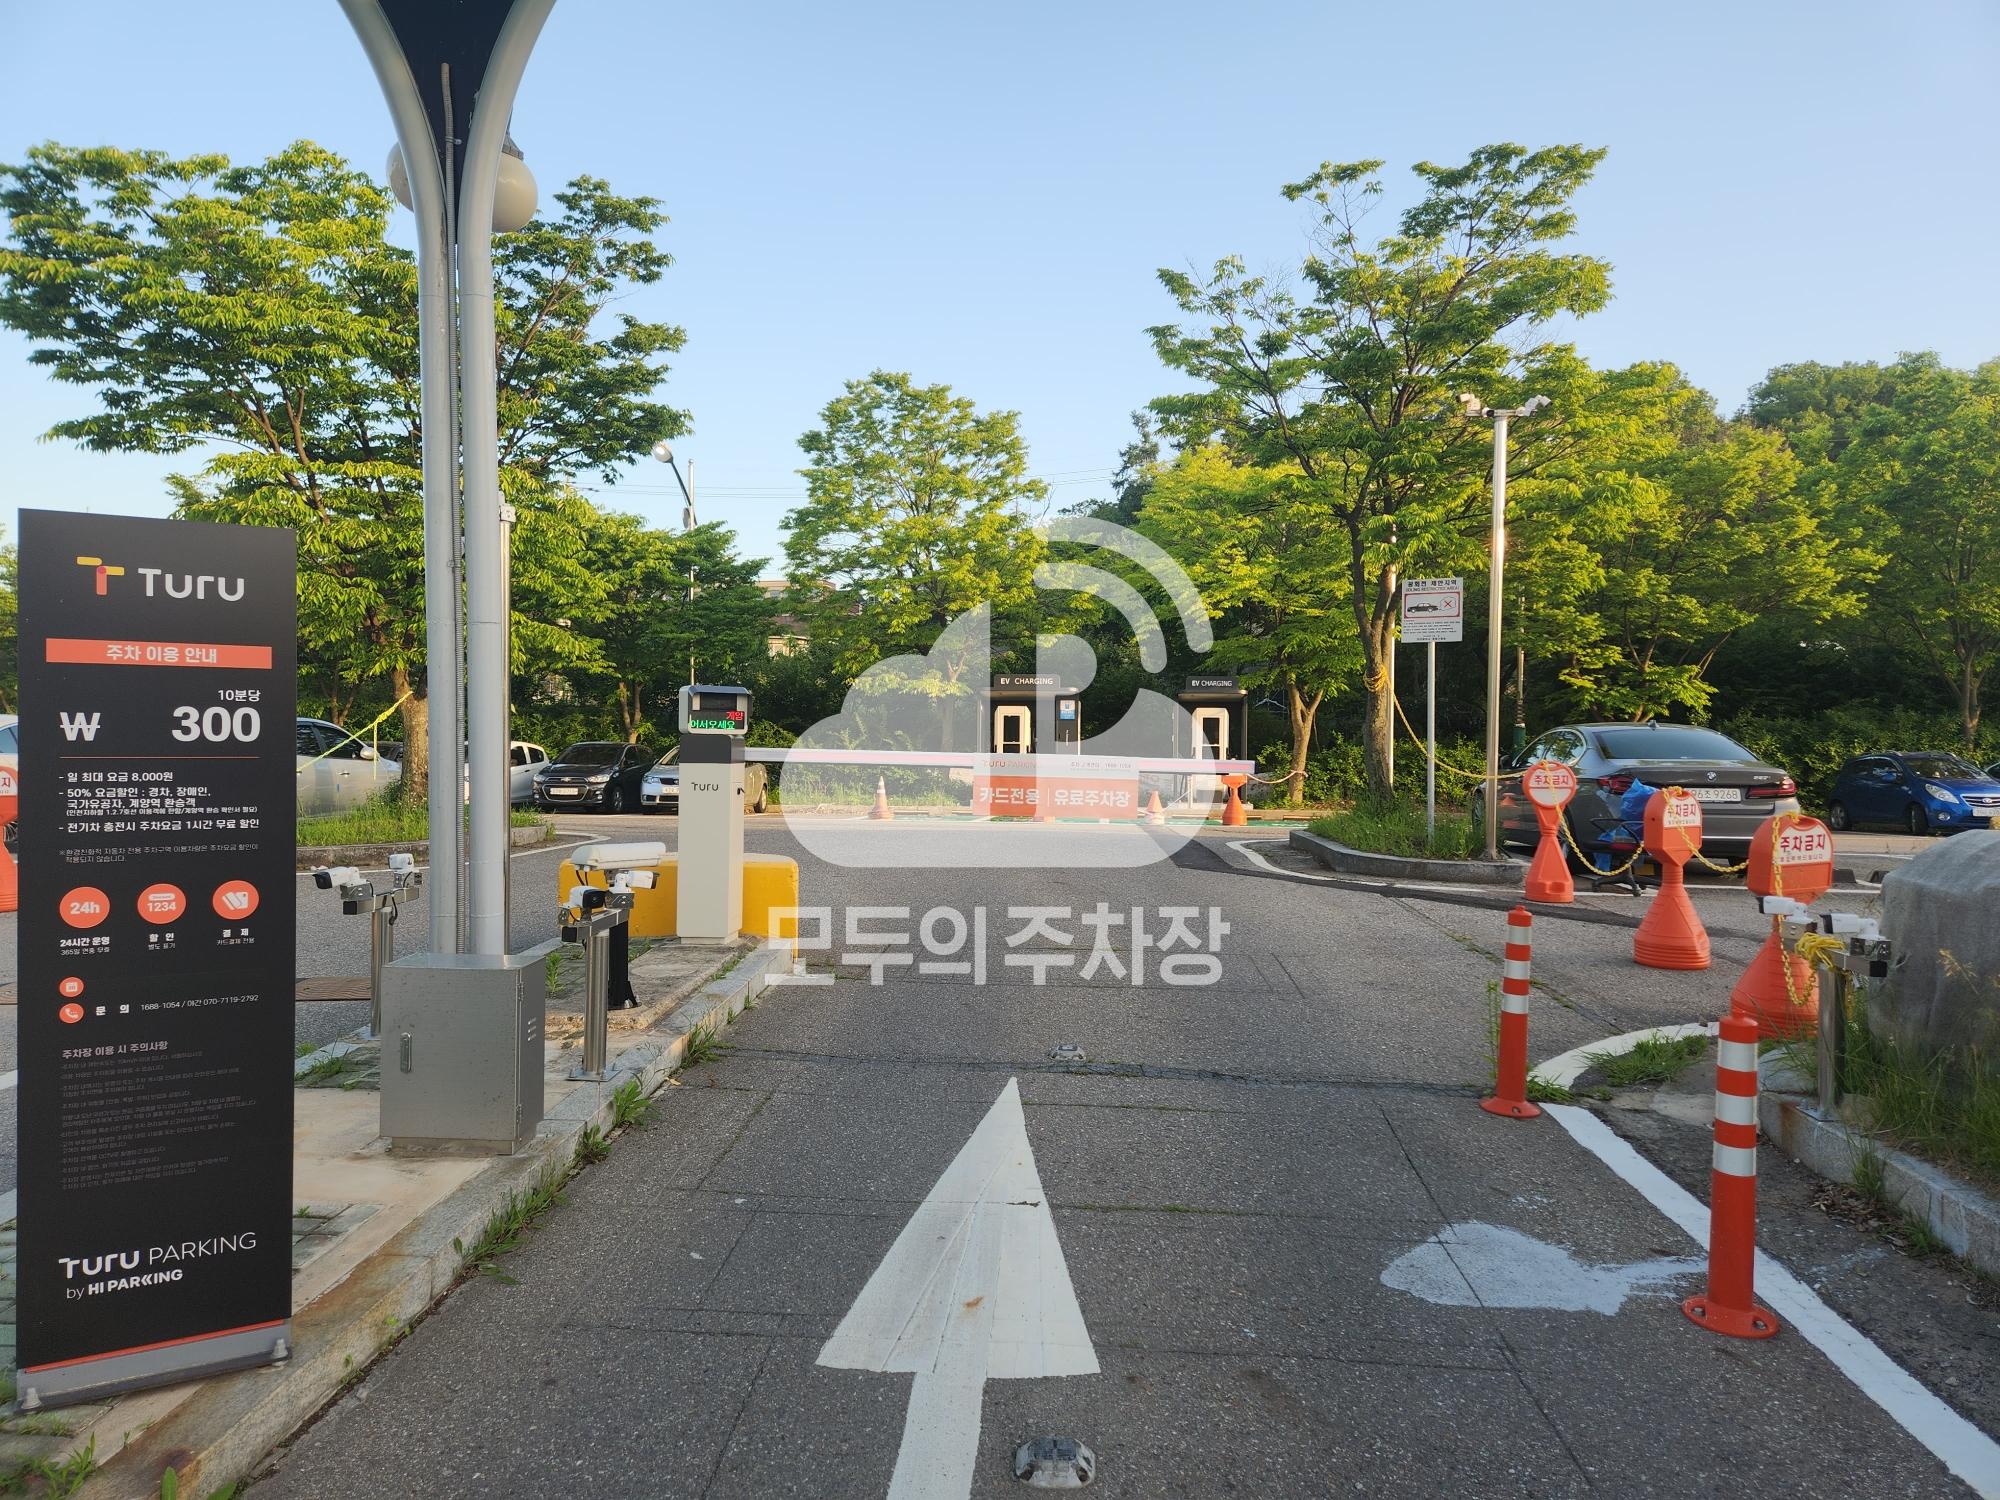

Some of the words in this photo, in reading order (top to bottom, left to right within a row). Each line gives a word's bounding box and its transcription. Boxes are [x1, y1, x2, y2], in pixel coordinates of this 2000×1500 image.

[106, 645, 141, 661] 주차
[146, 646, 180, 662] 이용
[185, 647, 217, 664] 안내
[1000, 677, 1011, 685] EV
[1014, 677, 1053, 685] CHARGING
[217, 689, 261, 702] 10분당
[171, 706, 261, 742] 300
[690, 719, 735, 729] 어서오세요
[67, 772, 78, 783] 일
[81, 772, 104, 782] 최대
[107, 772, 129, 782] 요금
[67, 788, 92, 797] 50%
[95, 787, 138, 798] 요금할인
[979, 787, 1041, 805] 카드전용
[1054, 788, 1131, 808] 유료주차장
[1713, 790, 1738, 800] 9268
[129, 798, 160, 808] 계양역
[164, 797, 196, 808] 환승객
[67, 822, 101, 833] 전기차
[104, 821, 136, 832] 충전시
[139, 820, 182, 831] 주차요금
[186, 820, 213, 830] 1시간
[216, 819, 237, 829] 무료
[240, 818, 259, 829] 할인
[1780, 833, 1825, 852] 주차금지
[70, 902, 100, 915] 24h
[147, 901, 177, 912] 1234
[60, 937, 90, 947] 24시간
[92, 936, 110, 946] 운영
[62, 1047, 92, 1059] 주차장
[95, 1045, 114, 1056] 이용
[117, 1044, 127, 1054] 시
[130, 1040, 168, 1053] 주의사항
[149, 1232, 257, 1265] PARKING
[66, 1287, 85, 1300] by
[88, 1283, 104, 1296] HI
[107, 1269, 184, 1292] PARKING
